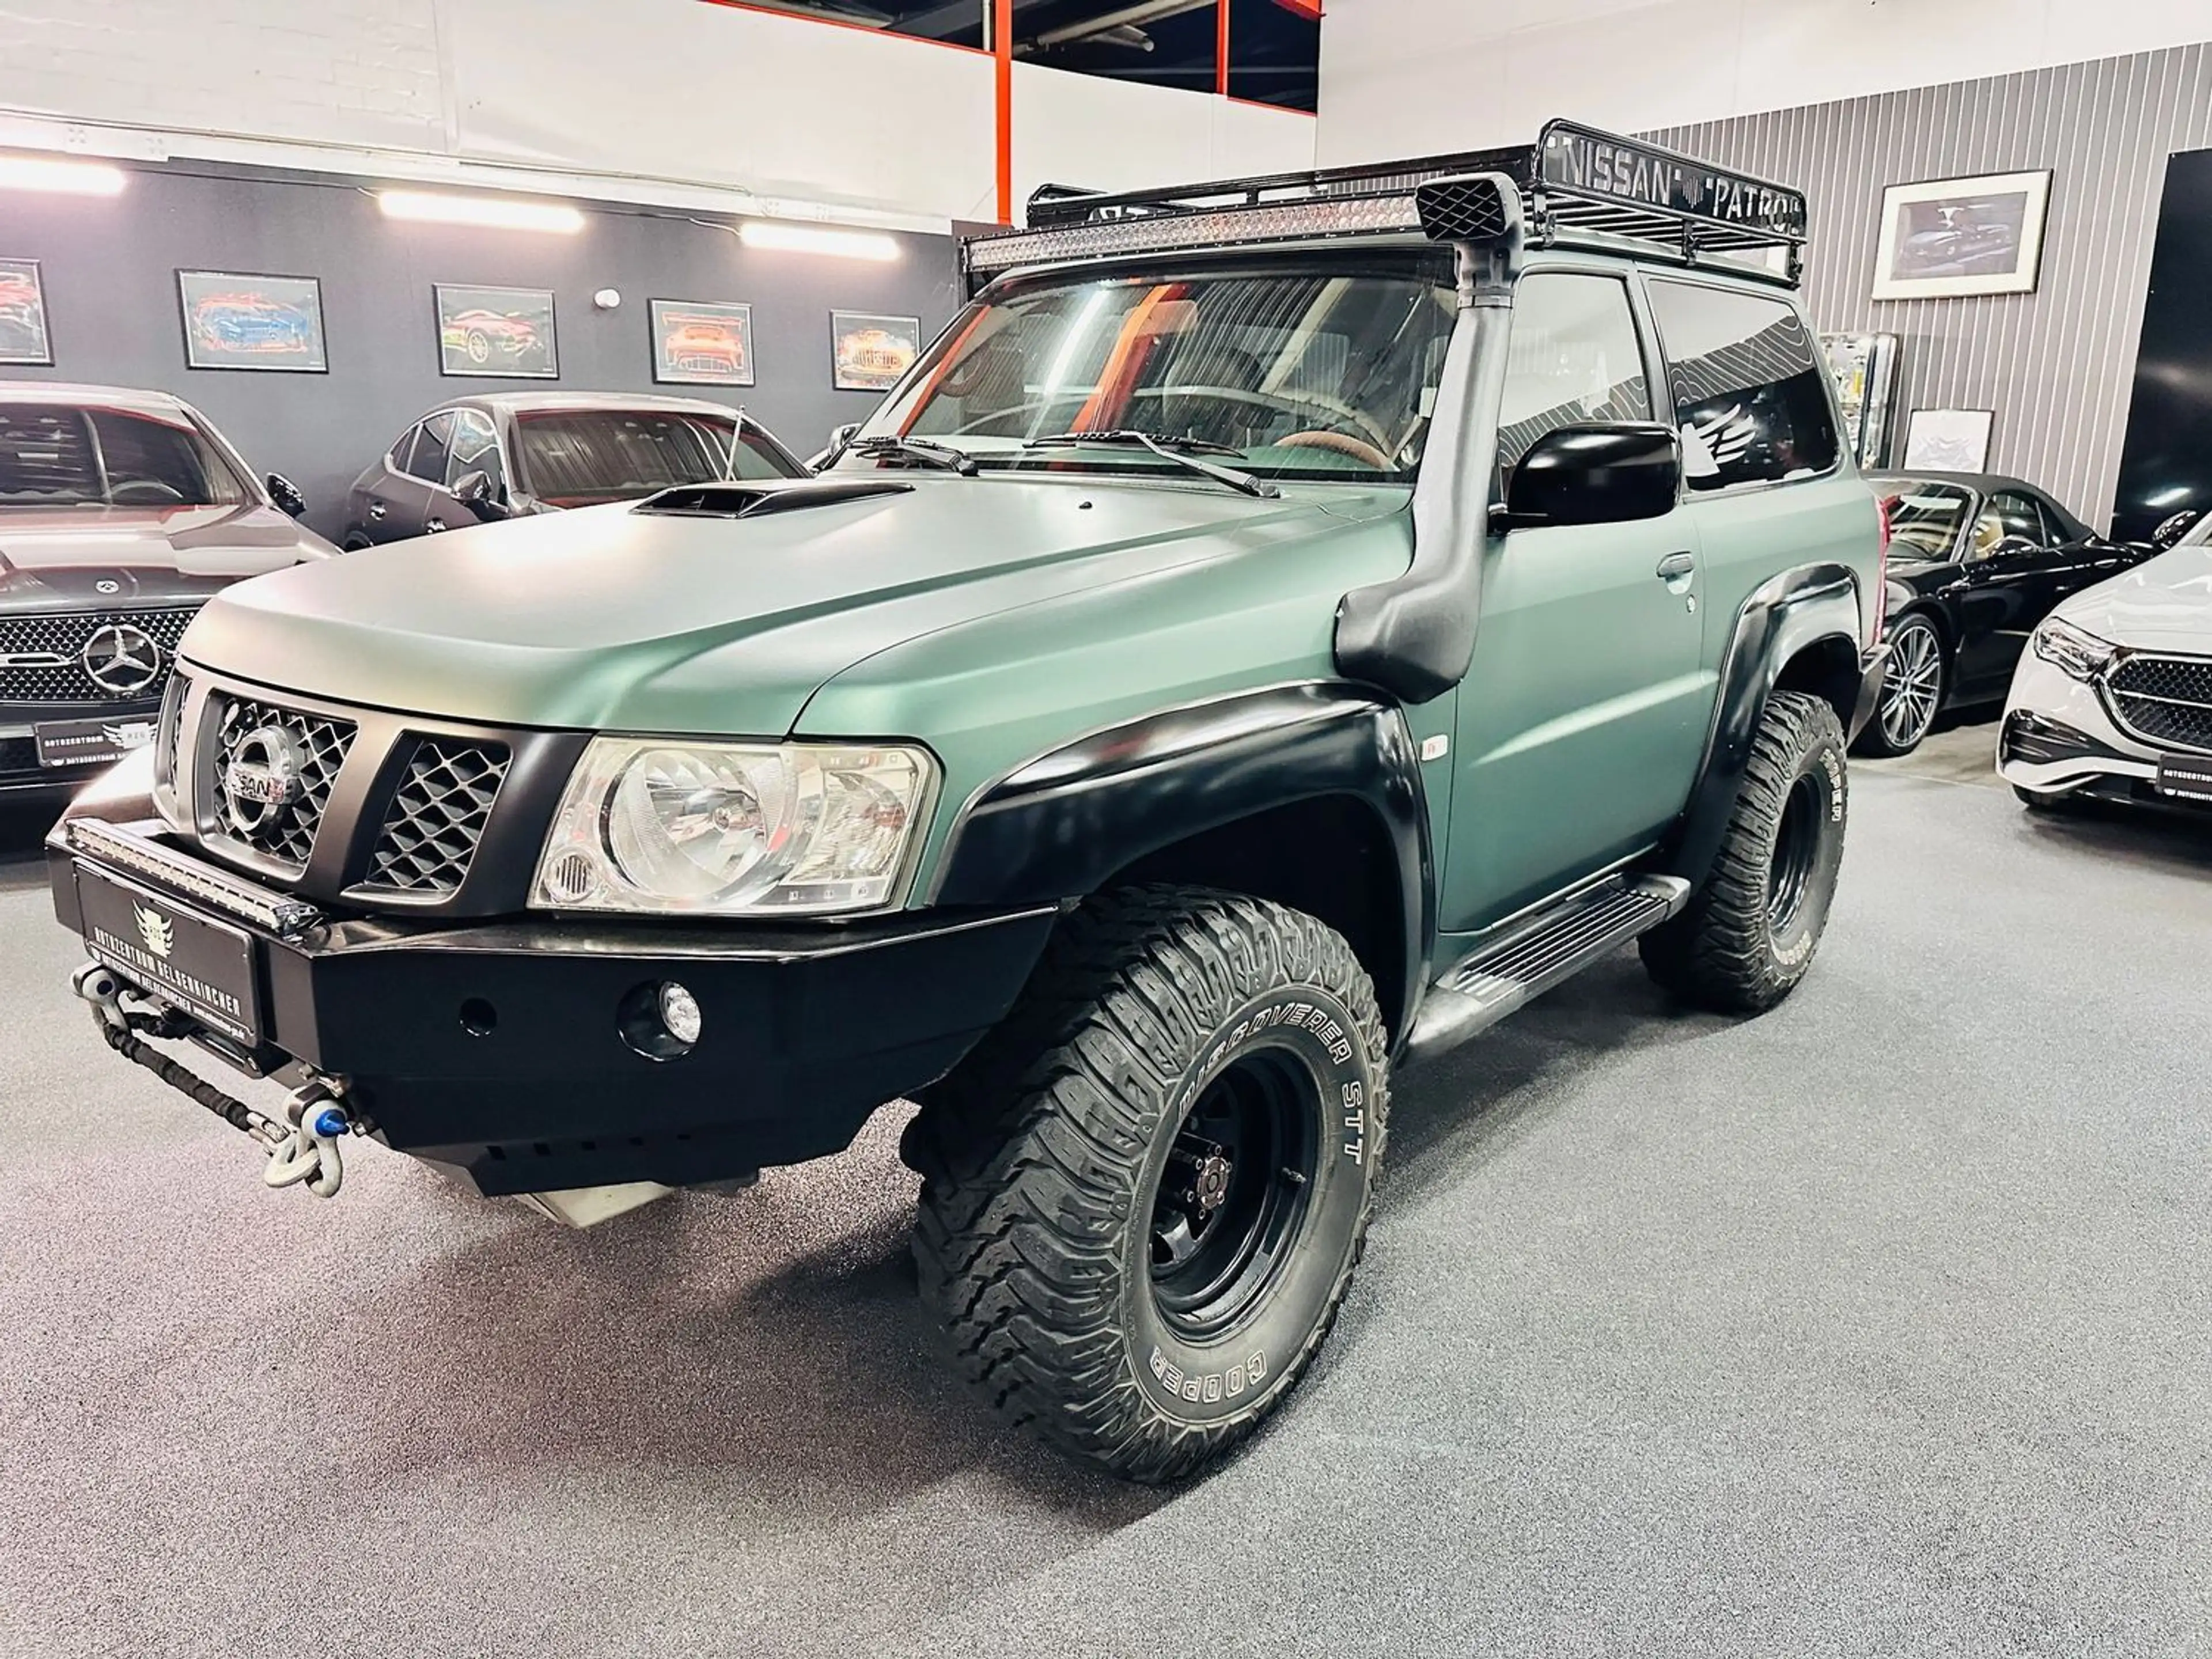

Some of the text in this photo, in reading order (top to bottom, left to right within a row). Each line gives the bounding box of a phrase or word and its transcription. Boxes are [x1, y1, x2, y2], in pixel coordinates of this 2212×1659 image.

[1561, 136, 1672, 206] NISSAN
[1342, 1081, 1364, 1165] STT
[1150, 1344, 1267, 1403] COOPER
